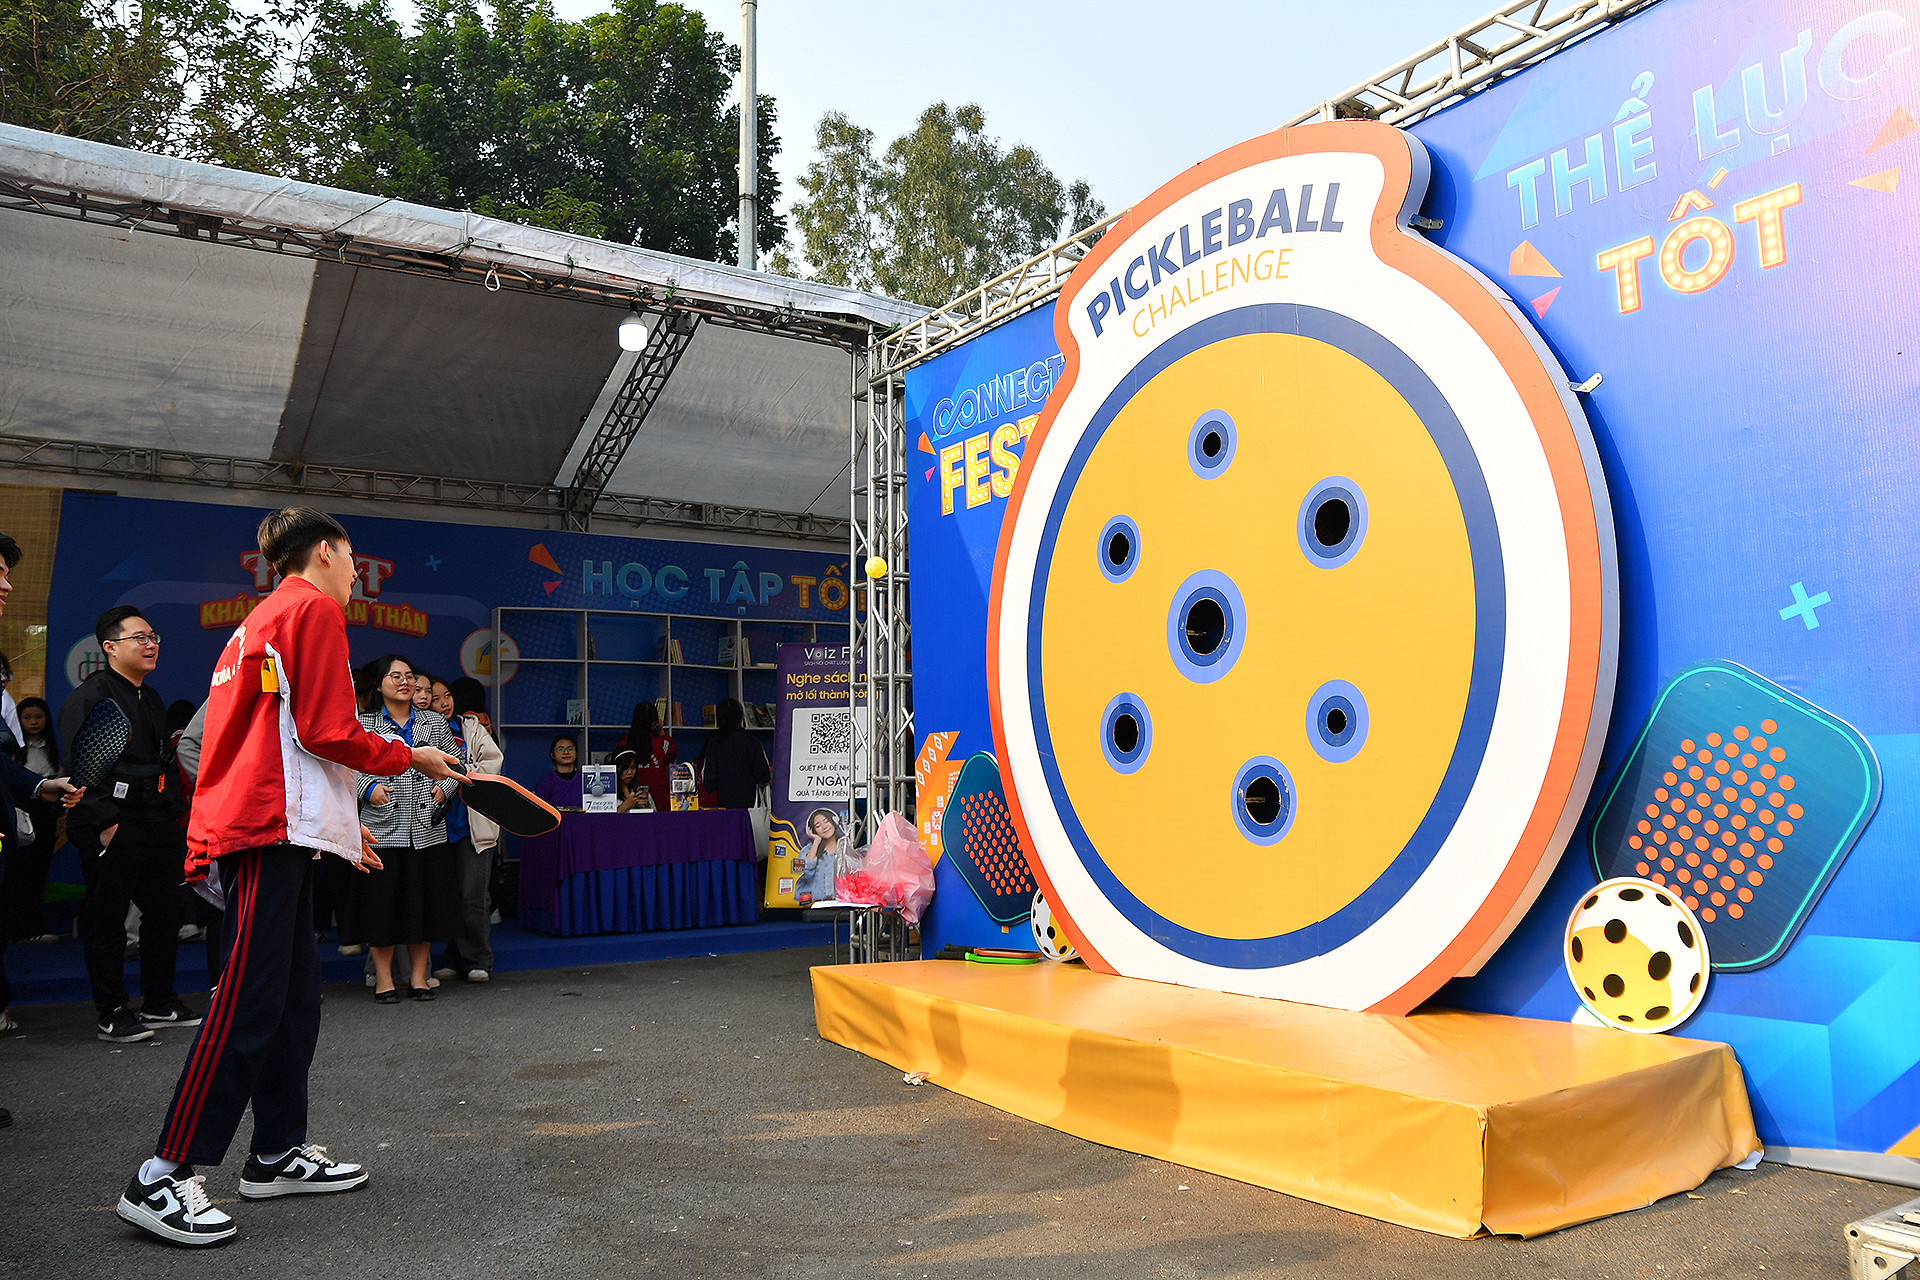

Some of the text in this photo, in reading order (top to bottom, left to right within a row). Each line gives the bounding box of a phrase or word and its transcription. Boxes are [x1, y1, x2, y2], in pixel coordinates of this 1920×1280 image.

[1506, 10, 1911, 231] THỂ LỰC
[1086, 182, 1344, 338] PICKLEBALL
[1597, 167, 1803, 315] TỐT
[1132, 248, 1293, 338] CHALLENGE
[582, 559, 689, 609] HỌC
[704, 560, 784, 614] TẬP
[374, 604, 428, 633] THÂN
[786, 673, 821, 688] Nghe
[786, 691, 804, 700] mở
[805, 688, 817, 700] lối
[819, 689, 850, 700] thành
[807, 773, 850, 787] 7 NGÀY
[585, 800, 593, 811] 7
